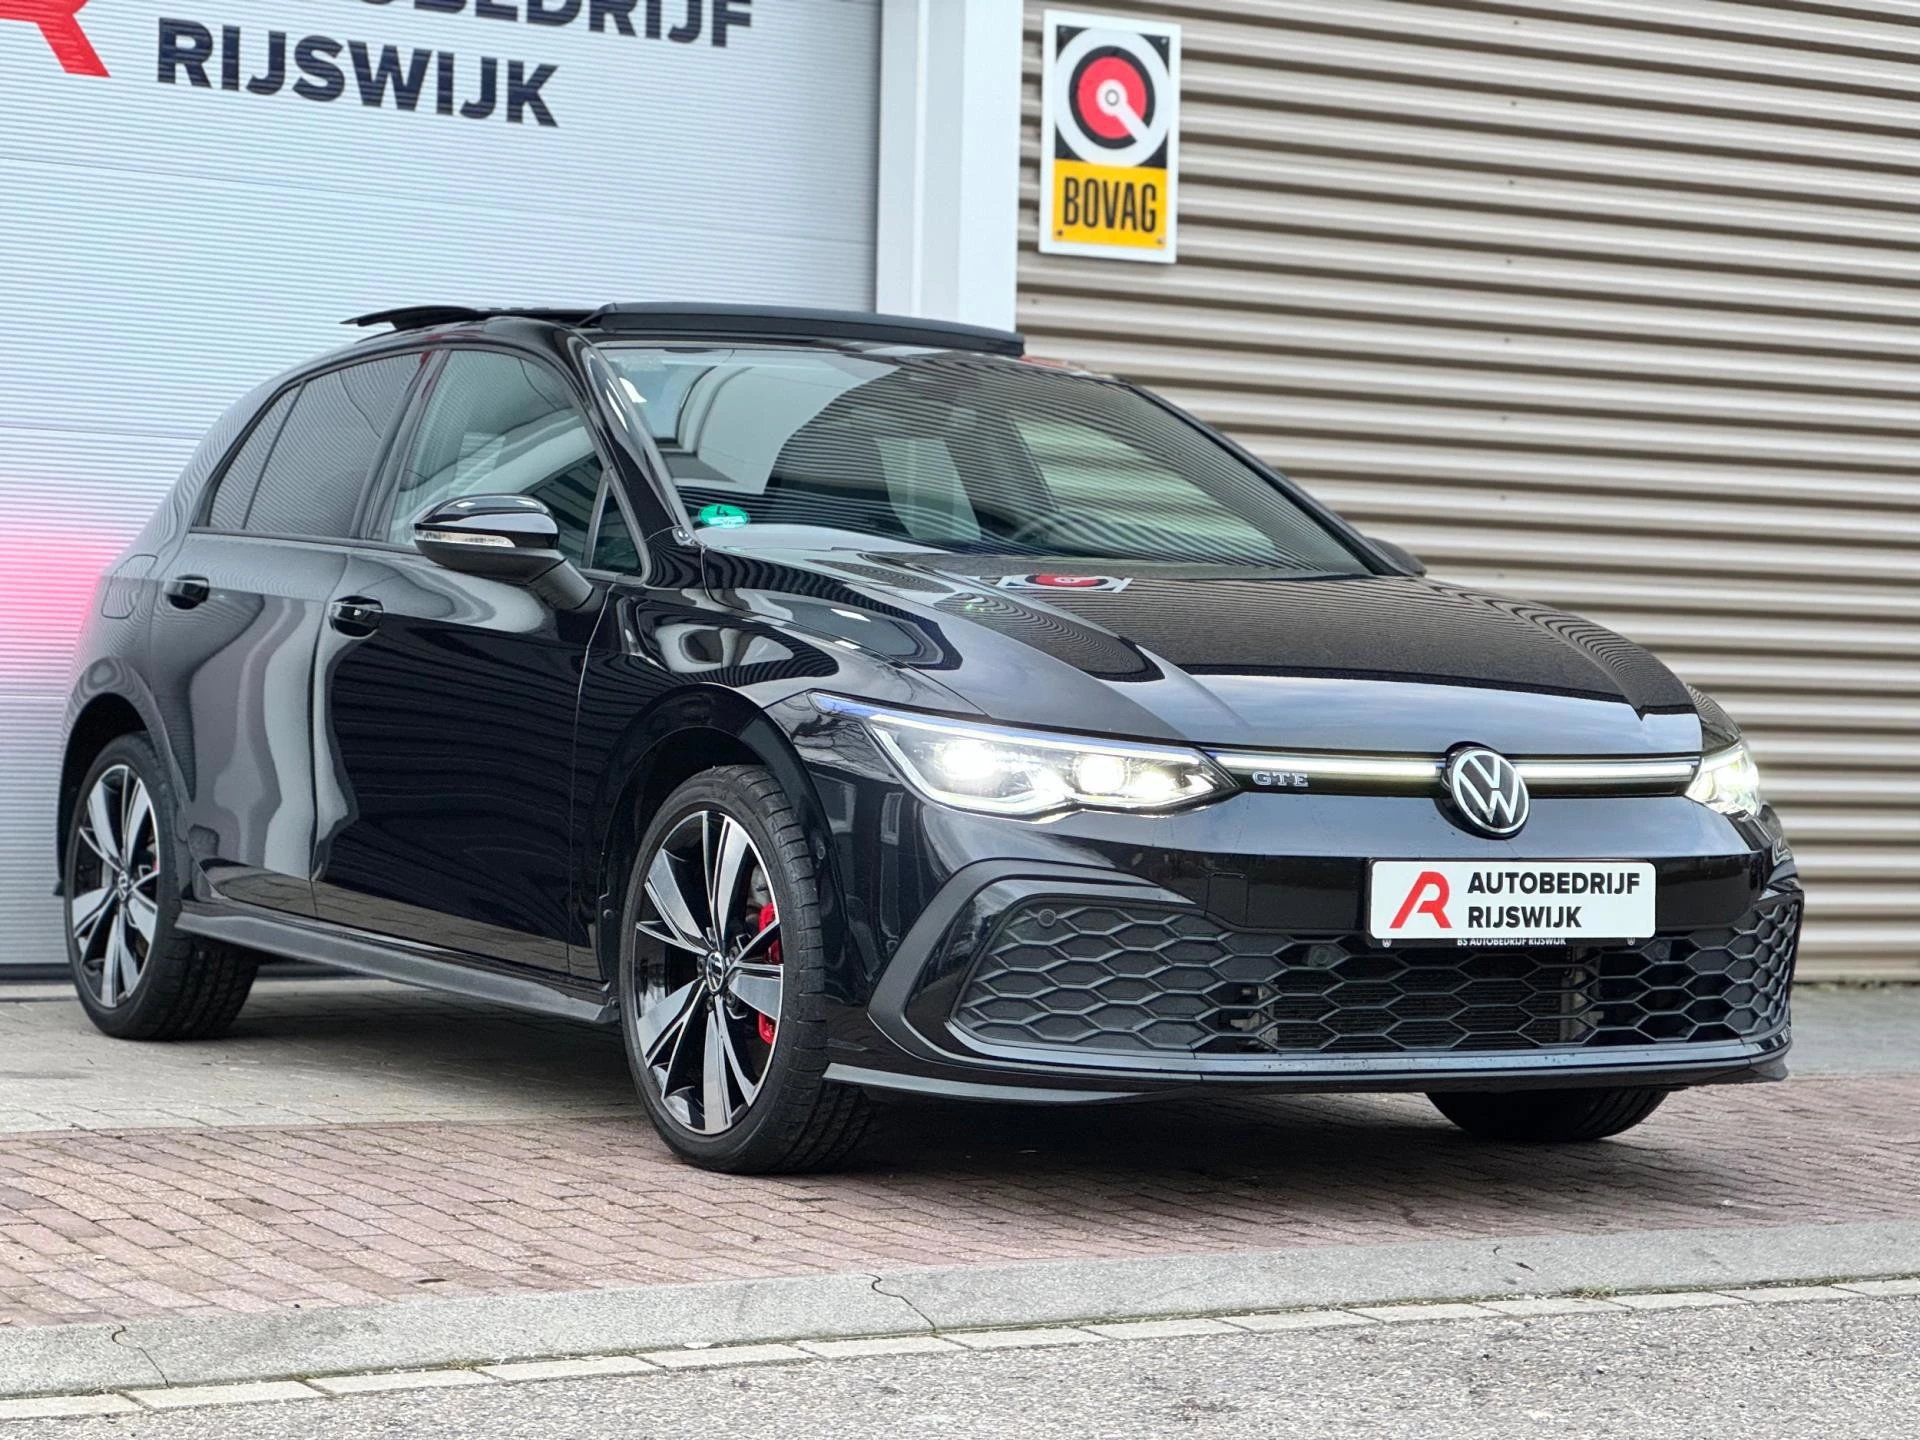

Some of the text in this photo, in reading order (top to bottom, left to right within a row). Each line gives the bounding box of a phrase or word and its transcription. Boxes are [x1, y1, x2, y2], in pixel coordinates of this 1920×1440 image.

[157, 17, 560, 128] RIJSWIJK
[1063, 176, 1158, 233] BOVAG
[1252, 770, 1309, 787] GTE
[1467, 872, 1641, 895] AUTOBEDRIJF
[1467, 906, 1582, 928] RIJSWIJK
[1469, 937, 1527, 946] AUTOBEDRIJF
[1528, 937, 1567, 946] RIJSWIJK
